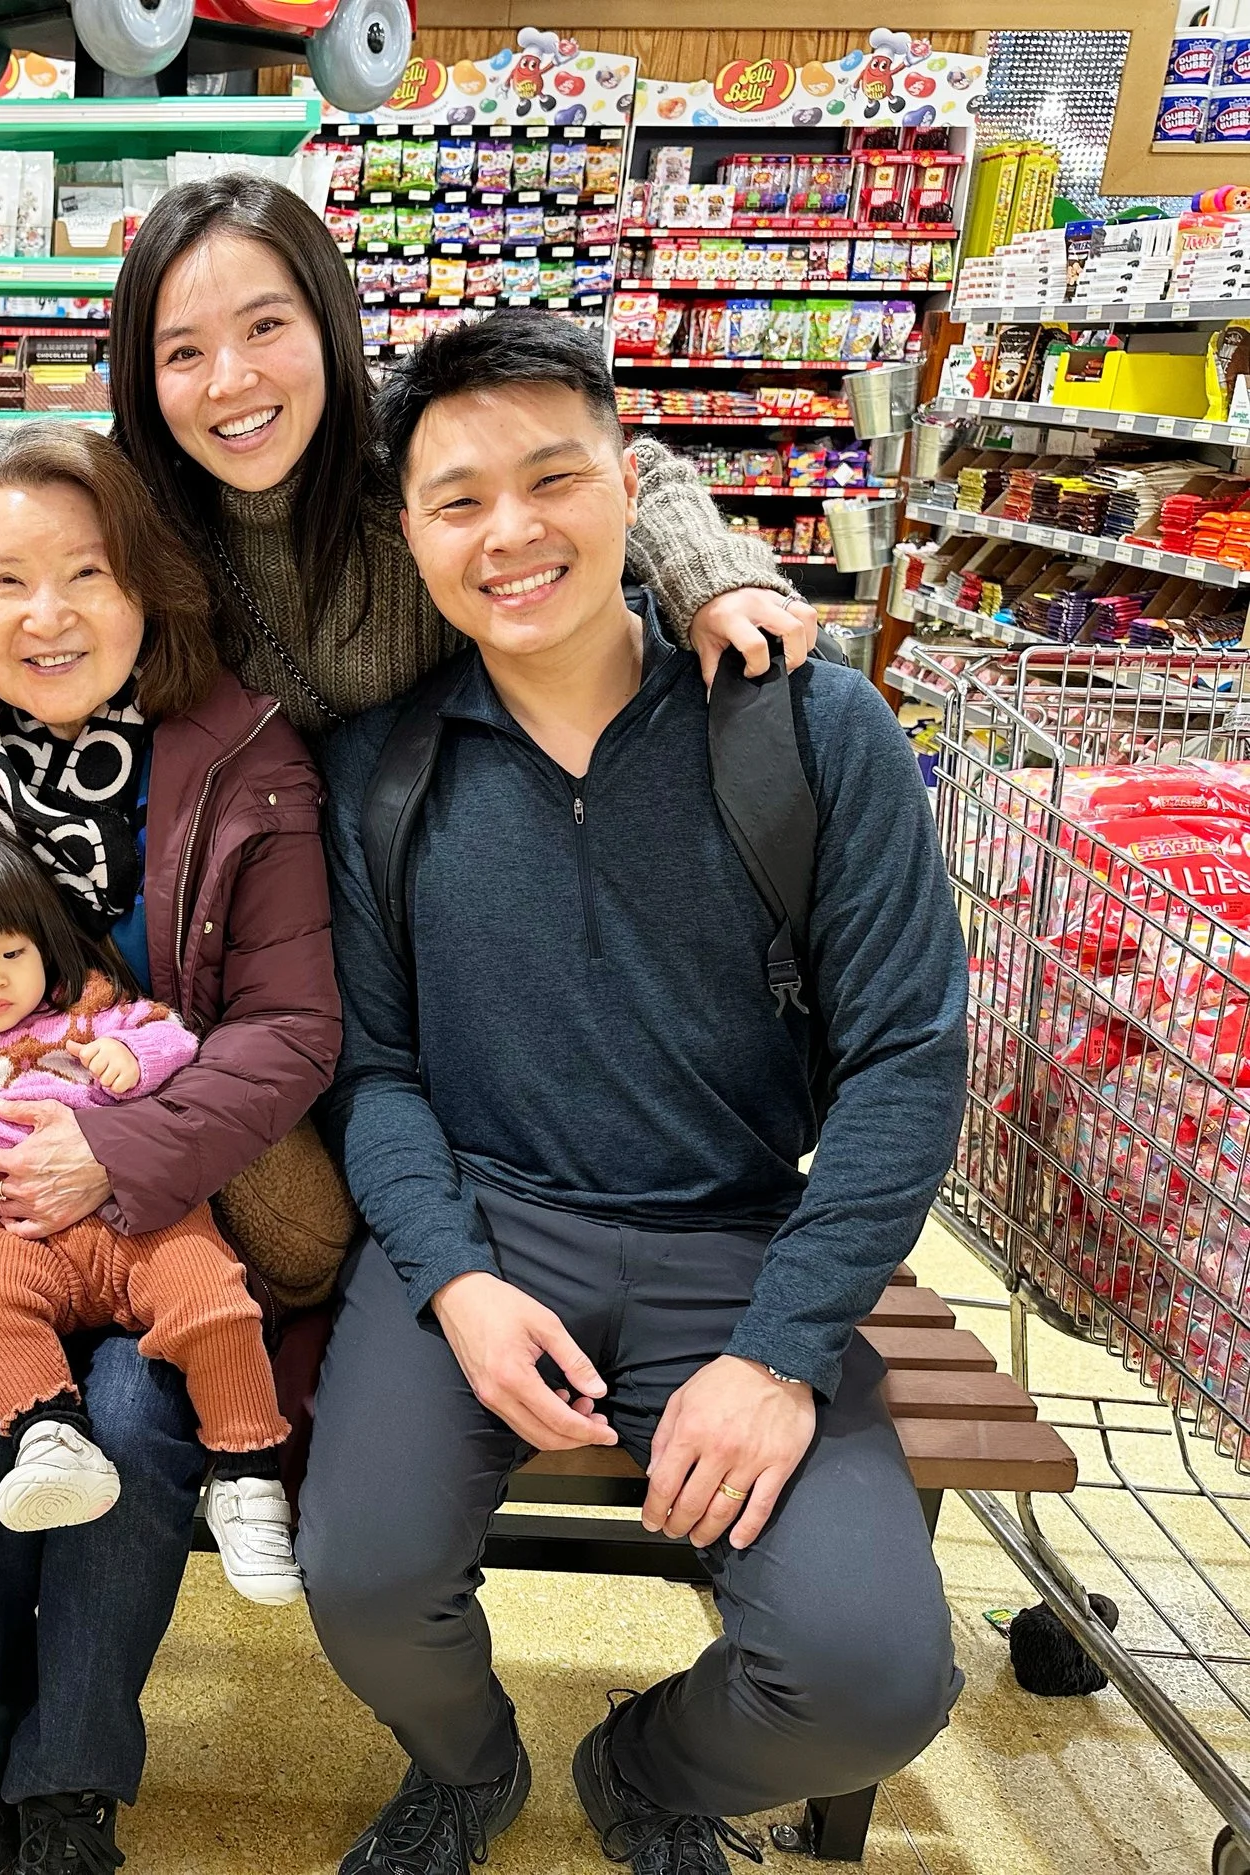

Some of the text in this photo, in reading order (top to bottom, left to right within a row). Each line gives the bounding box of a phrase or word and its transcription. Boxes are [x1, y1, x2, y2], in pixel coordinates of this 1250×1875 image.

[1178, 53, 1213, 65] DUBBLE
[738, 59, 776, 87] Jelly
[1179, 61, 1213, 73] BUBBLE
[723, 82, 766, 109] Belly
[1164, 110, 1200, 121] DUBBLE
[1219, 111, 1250, 122] DUBBL
[1164, 118, 1200, 130] BUBBLE
[1220, 118, 1250, 131] BUBBL
[1182, 233, 1222, 250] Twix
[1163, 798, 1206, 807] SMARTIES
